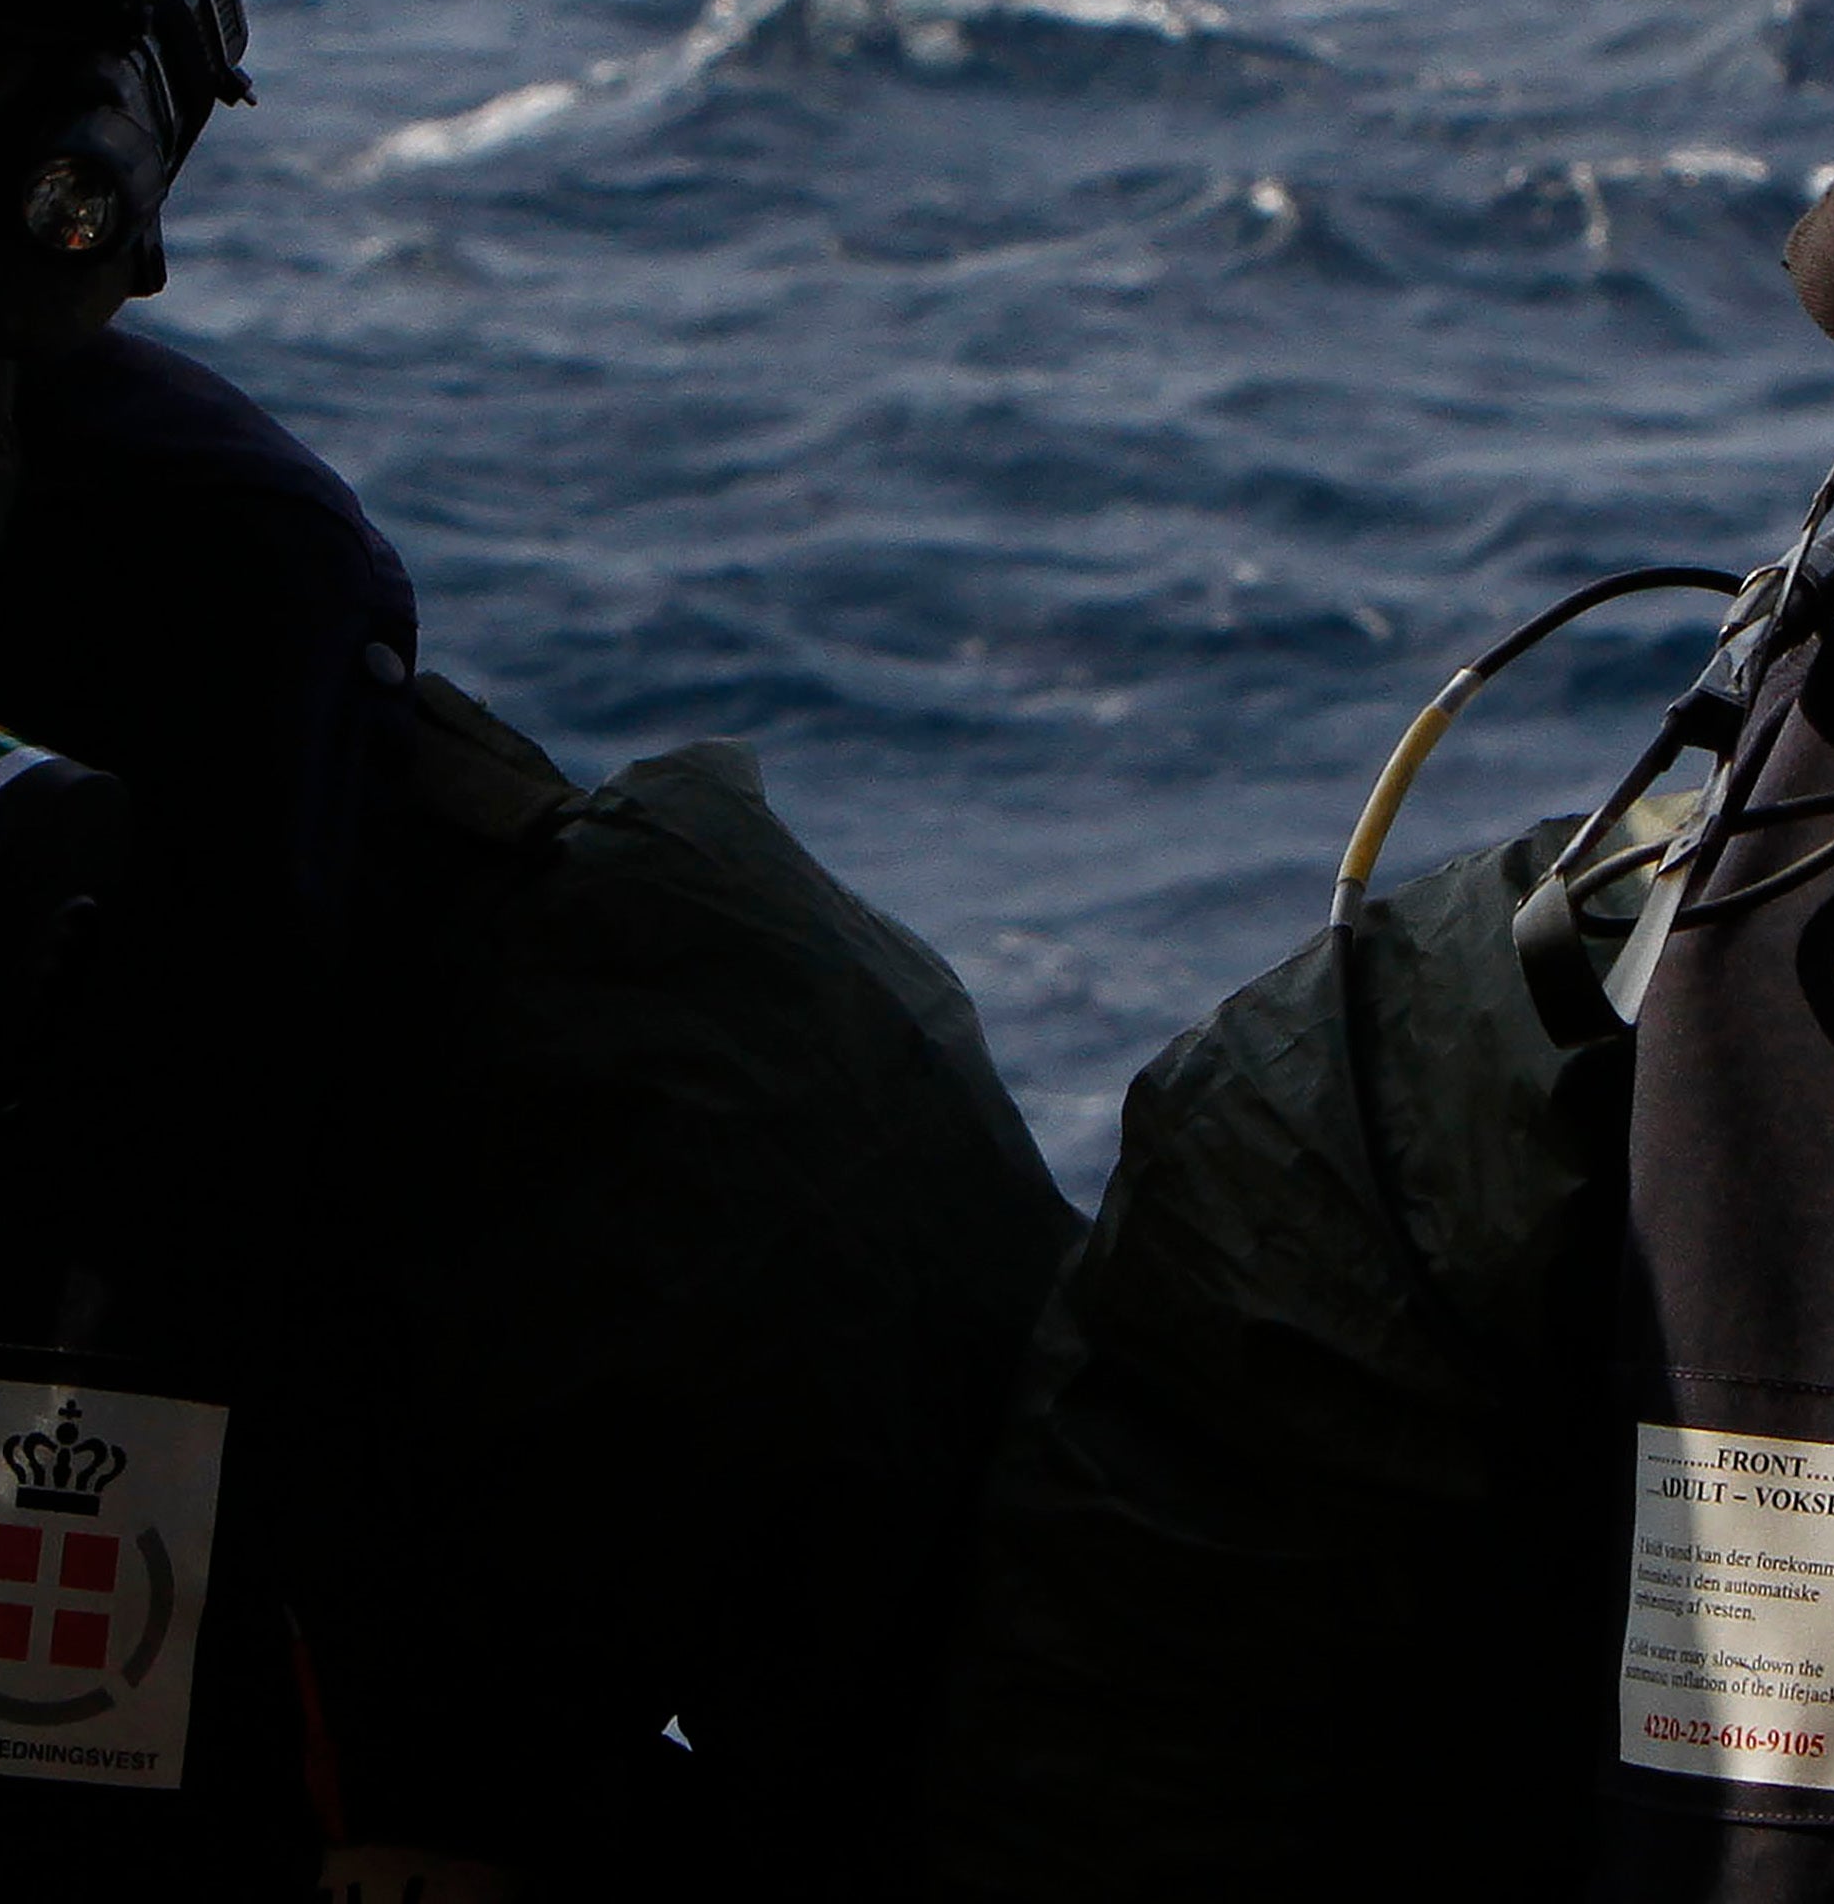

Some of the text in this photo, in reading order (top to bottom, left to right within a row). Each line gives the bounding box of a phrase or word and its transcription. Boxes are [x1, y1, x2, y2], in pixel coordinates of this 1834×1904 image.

[1695, 1545, 1722, 1566] kan
[1726, 1549, 1752, 1568] der
[1694, 1573, 1720, 1592] den
[1724, 1576, 1821, 1604] automatiske
[1752, 1654, 1794, 1675] down
[1799, 1659, 1825, 1679] the
[1731, 1678, 1750, 1696] of
[1751, 1677, 1774, 1698] the
